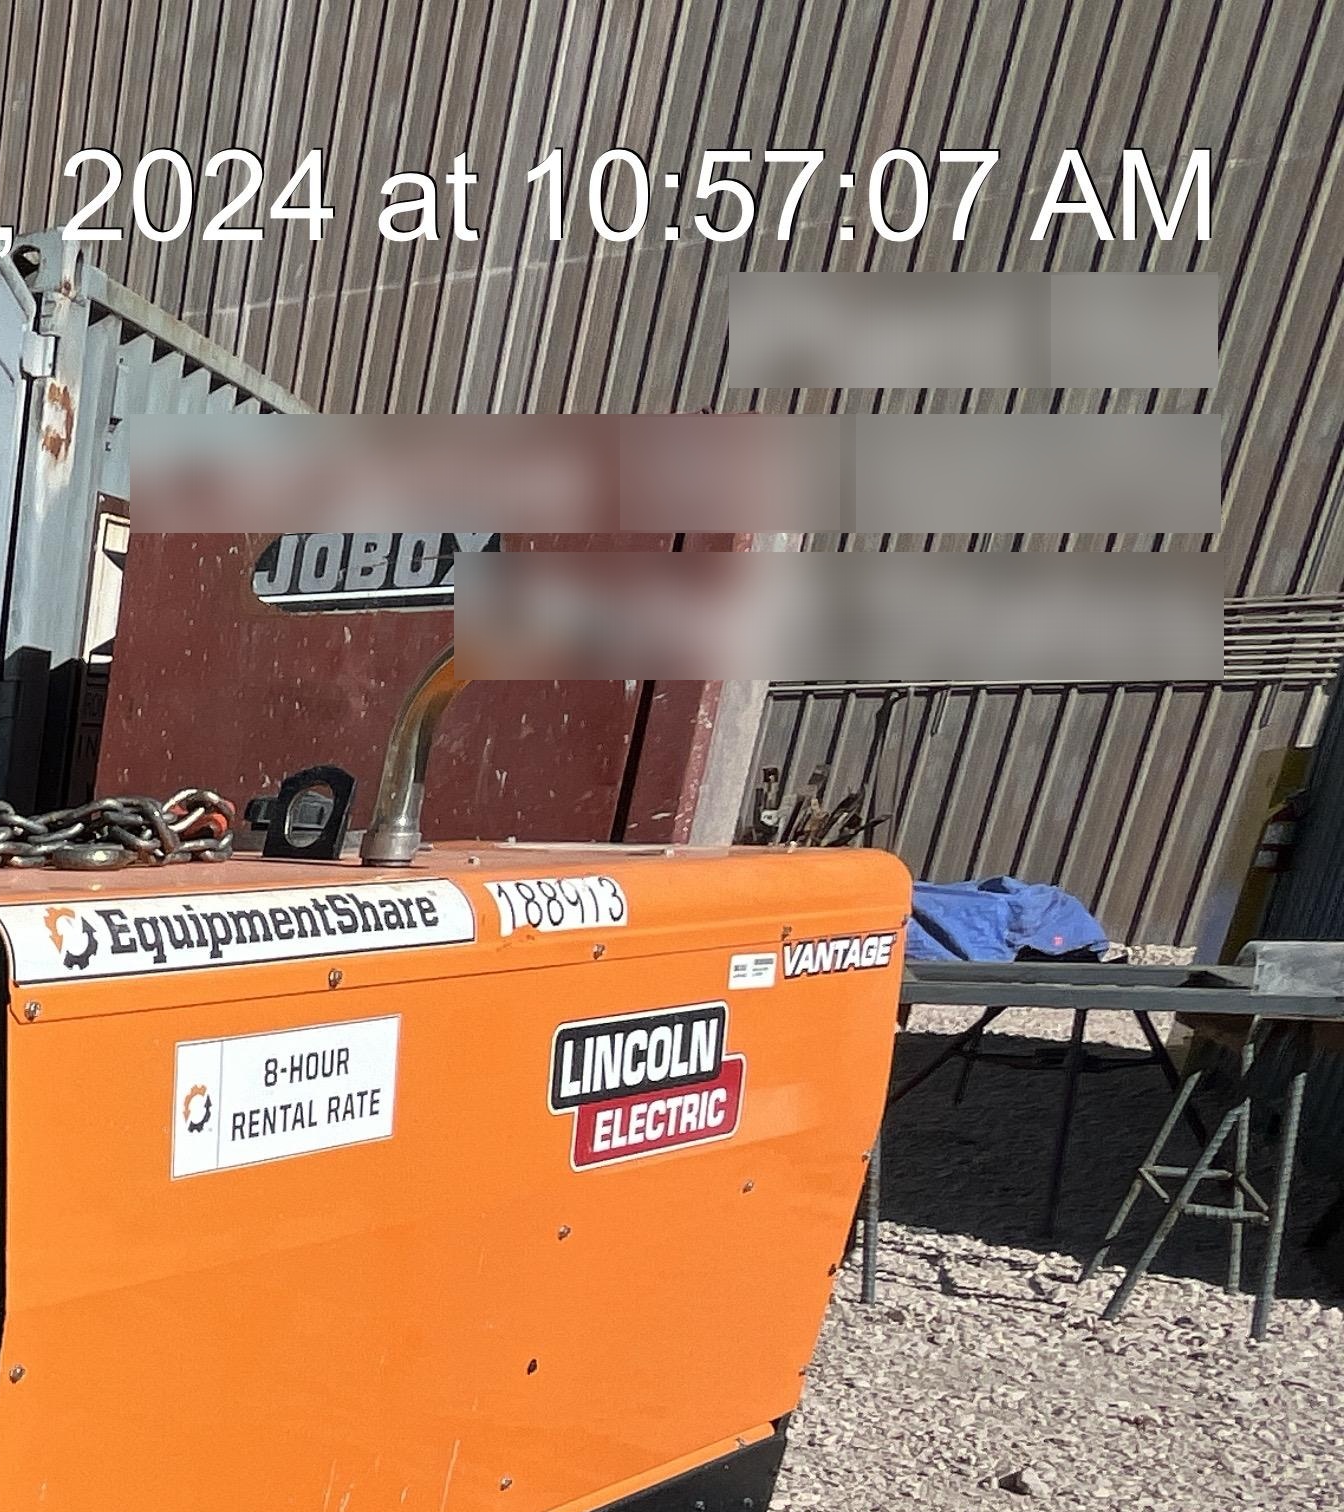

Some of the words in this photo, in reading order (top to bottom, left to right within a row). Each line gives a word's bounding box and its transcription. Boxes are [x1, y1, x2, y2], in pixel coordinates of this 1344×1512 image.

[97, 893, 440, 965] EquipmentShare
[497, 876, 624, 930] 188913
[782, 934, 894, 979] VANTAGE
[264, 1046, 350, 1088] 8-HOUR
[559, 1017, 720, 1098] LINCOLN
[230, 1099, 318, 1142] RENTAL
[327, 1087, 381, 1125] RATE
[592, 1087, 728, 1153] ELECTRIC
